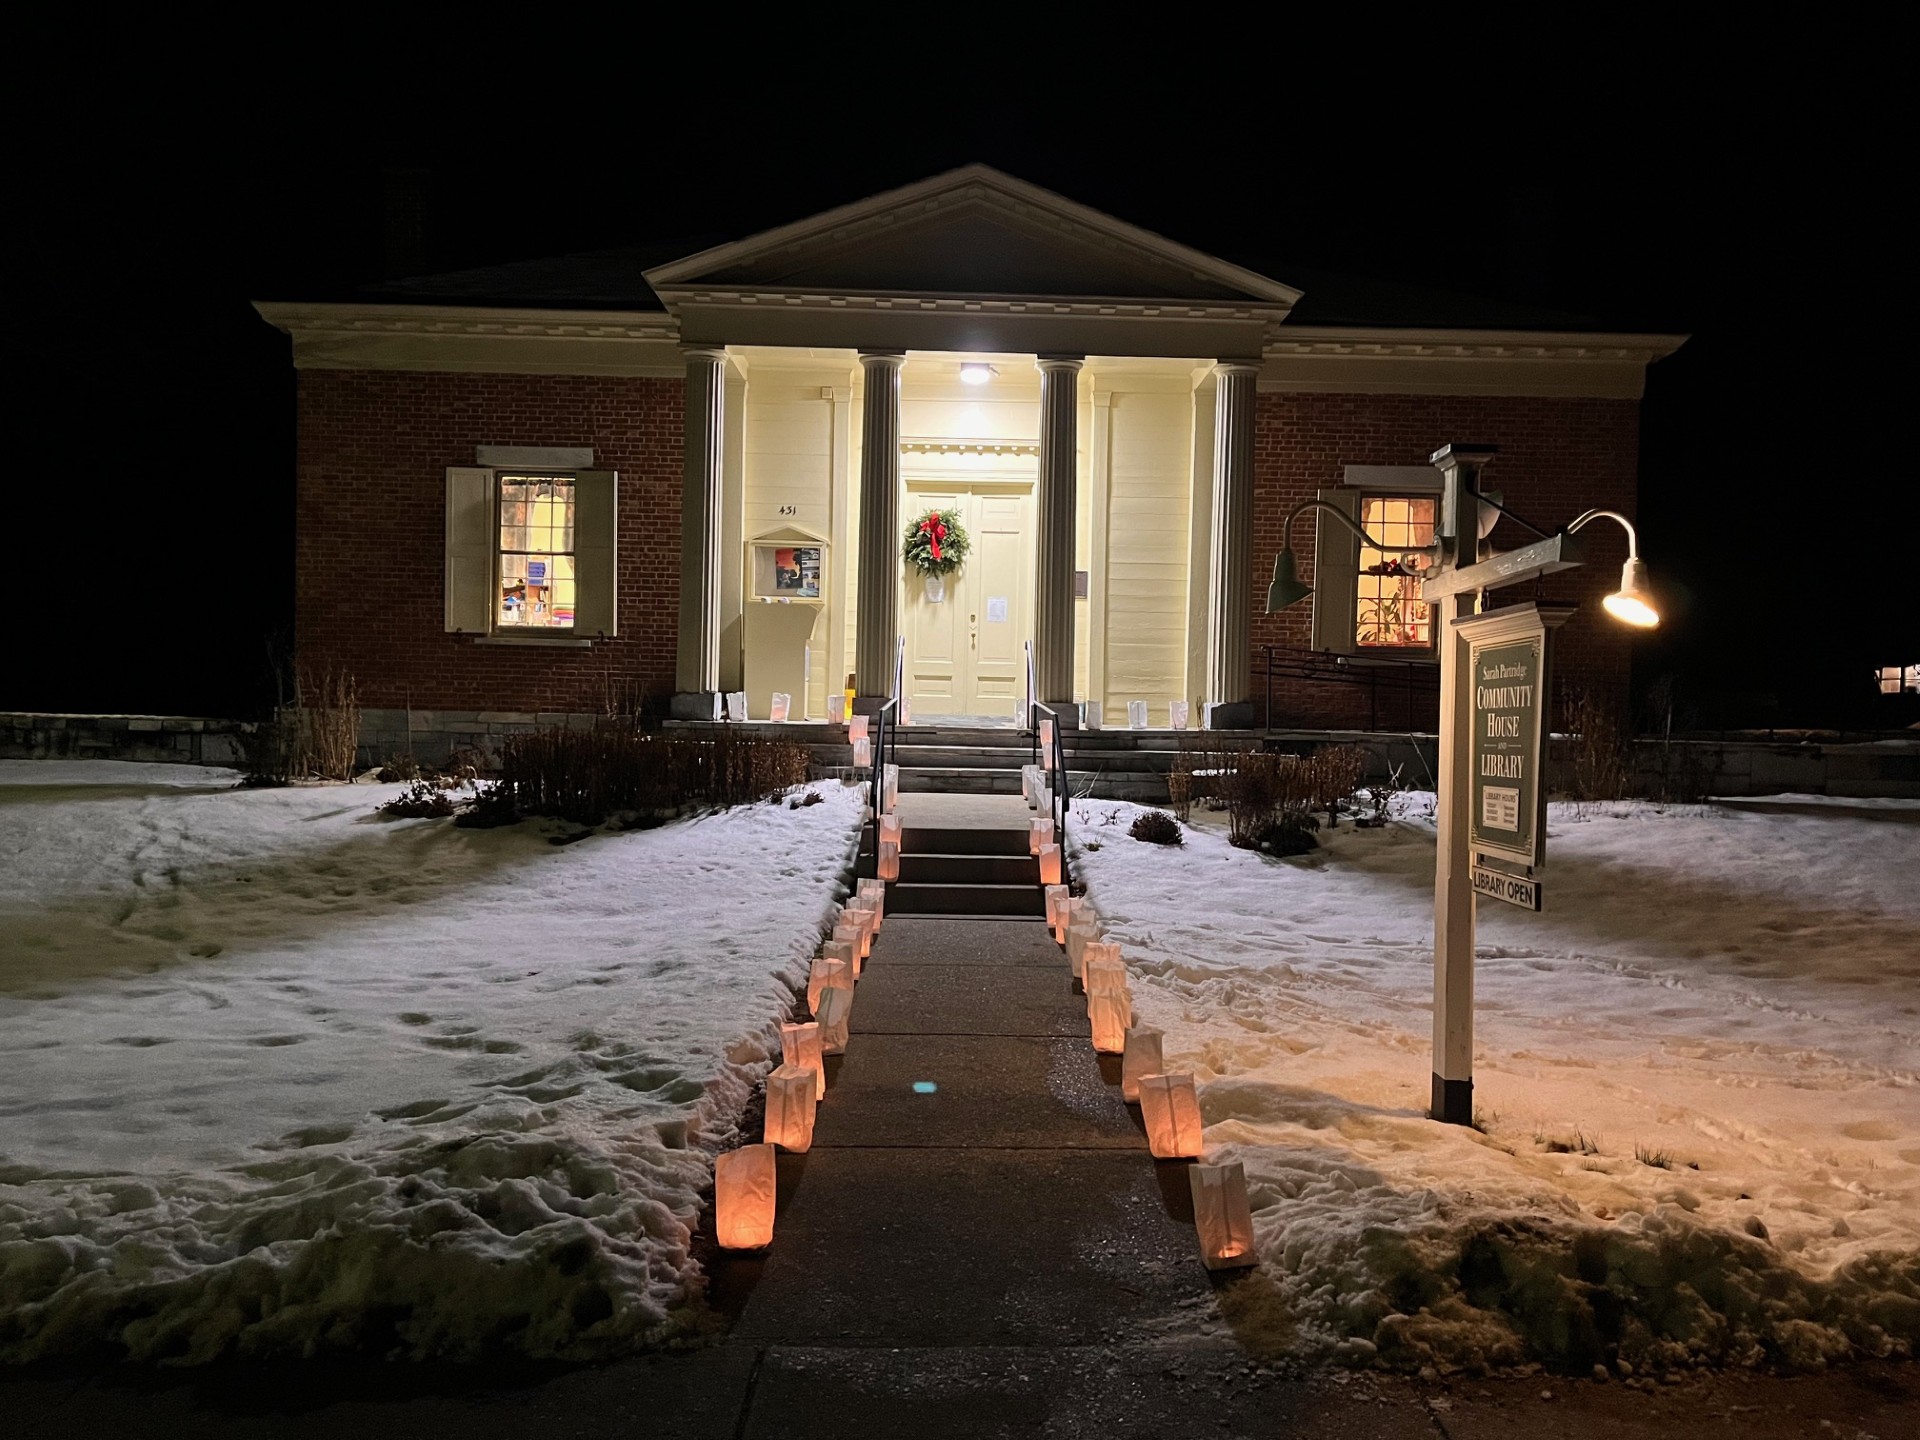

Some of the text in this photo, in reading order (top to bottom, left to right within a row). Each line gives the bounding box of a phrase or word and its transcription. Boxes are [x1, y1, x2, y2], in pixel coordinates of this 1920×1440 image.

[1483, 661, 1528, 681] Sarah Partridge
[1477, 685, 1533, 710] COMMUNITY
[1487, 712, 1520, 738] HOUSE
[1481, 753, 1524, 779] LIBRARY
[1473, 870, 1533, 906] LIBRARY OPEN
